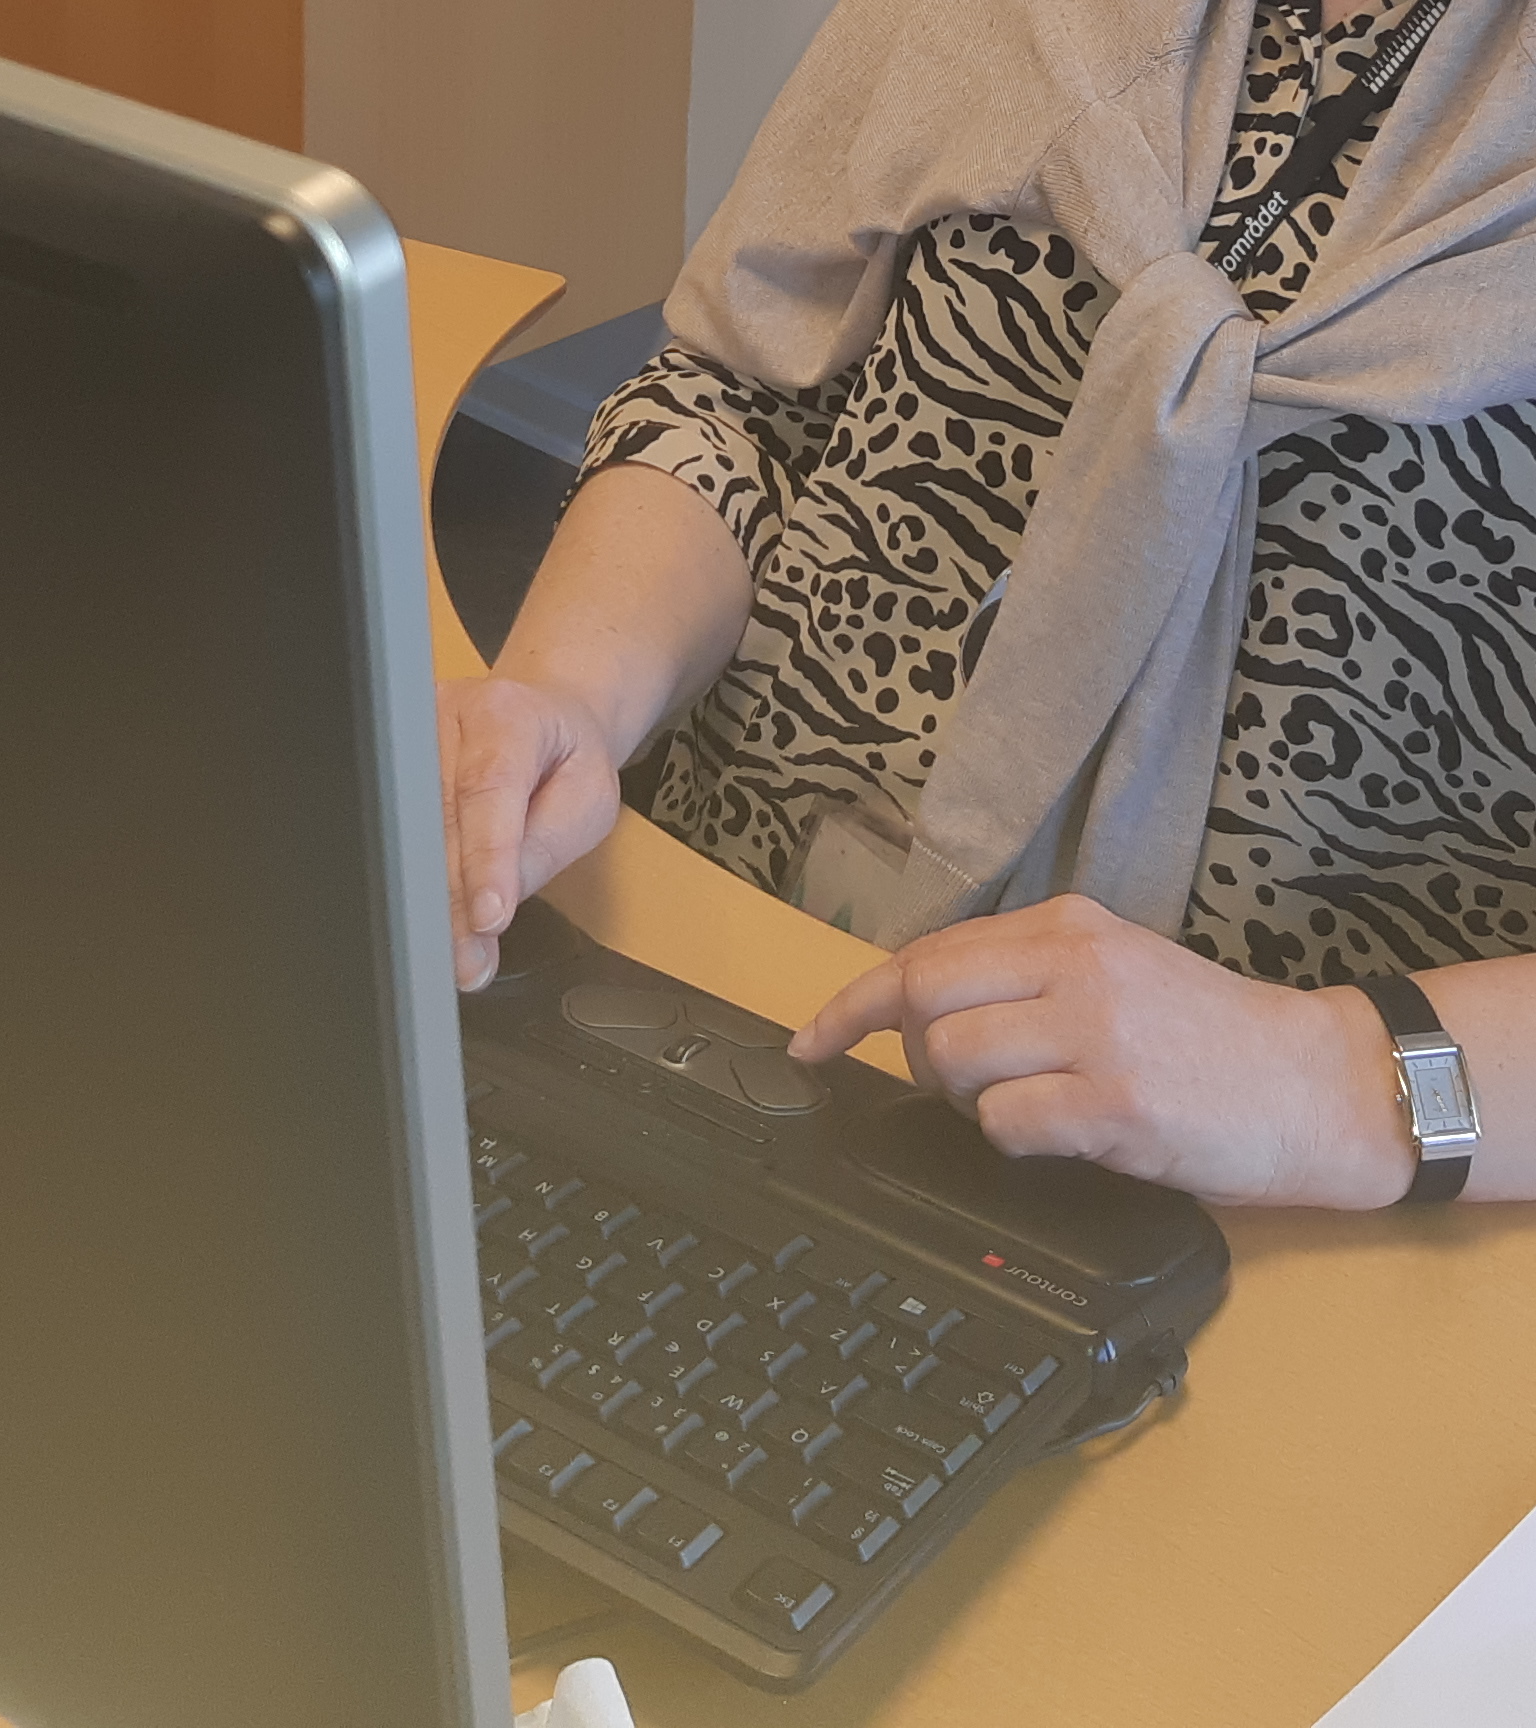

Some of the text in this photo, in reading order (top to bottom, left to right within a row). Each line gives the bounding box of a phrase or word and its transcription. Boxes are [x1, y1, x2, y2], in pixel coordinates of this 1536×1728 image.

[535, 1181, 554, 1194] N
[594, 1210, 610, 1222] B
[518, 1228, 538, 1241] H
[646, 1238, 664, 1250] V
[575, 1256, 593, 1270] G
[707, 1266, 725, 1278] C
[486, 1273, 502, 1285] Y
[1004, 1266, 1088, 1307] contour
[637, 1290, 654, 1302] F
[545, 1303, 561, 1315] T
[765, 1296, 786, 1310] X
[696, 1319, 714, 1332] D
[607, 1331, 625, 1346] R
[829, 1328, 848, 1341] Z
[759, 1350, 775, 1362] S
[668, 1365, 686, 1378] E
[820, 1380, 839, 1394] A
[719, 1394, 744, 1411] W
[791, 1427, 809, 1443] Q
